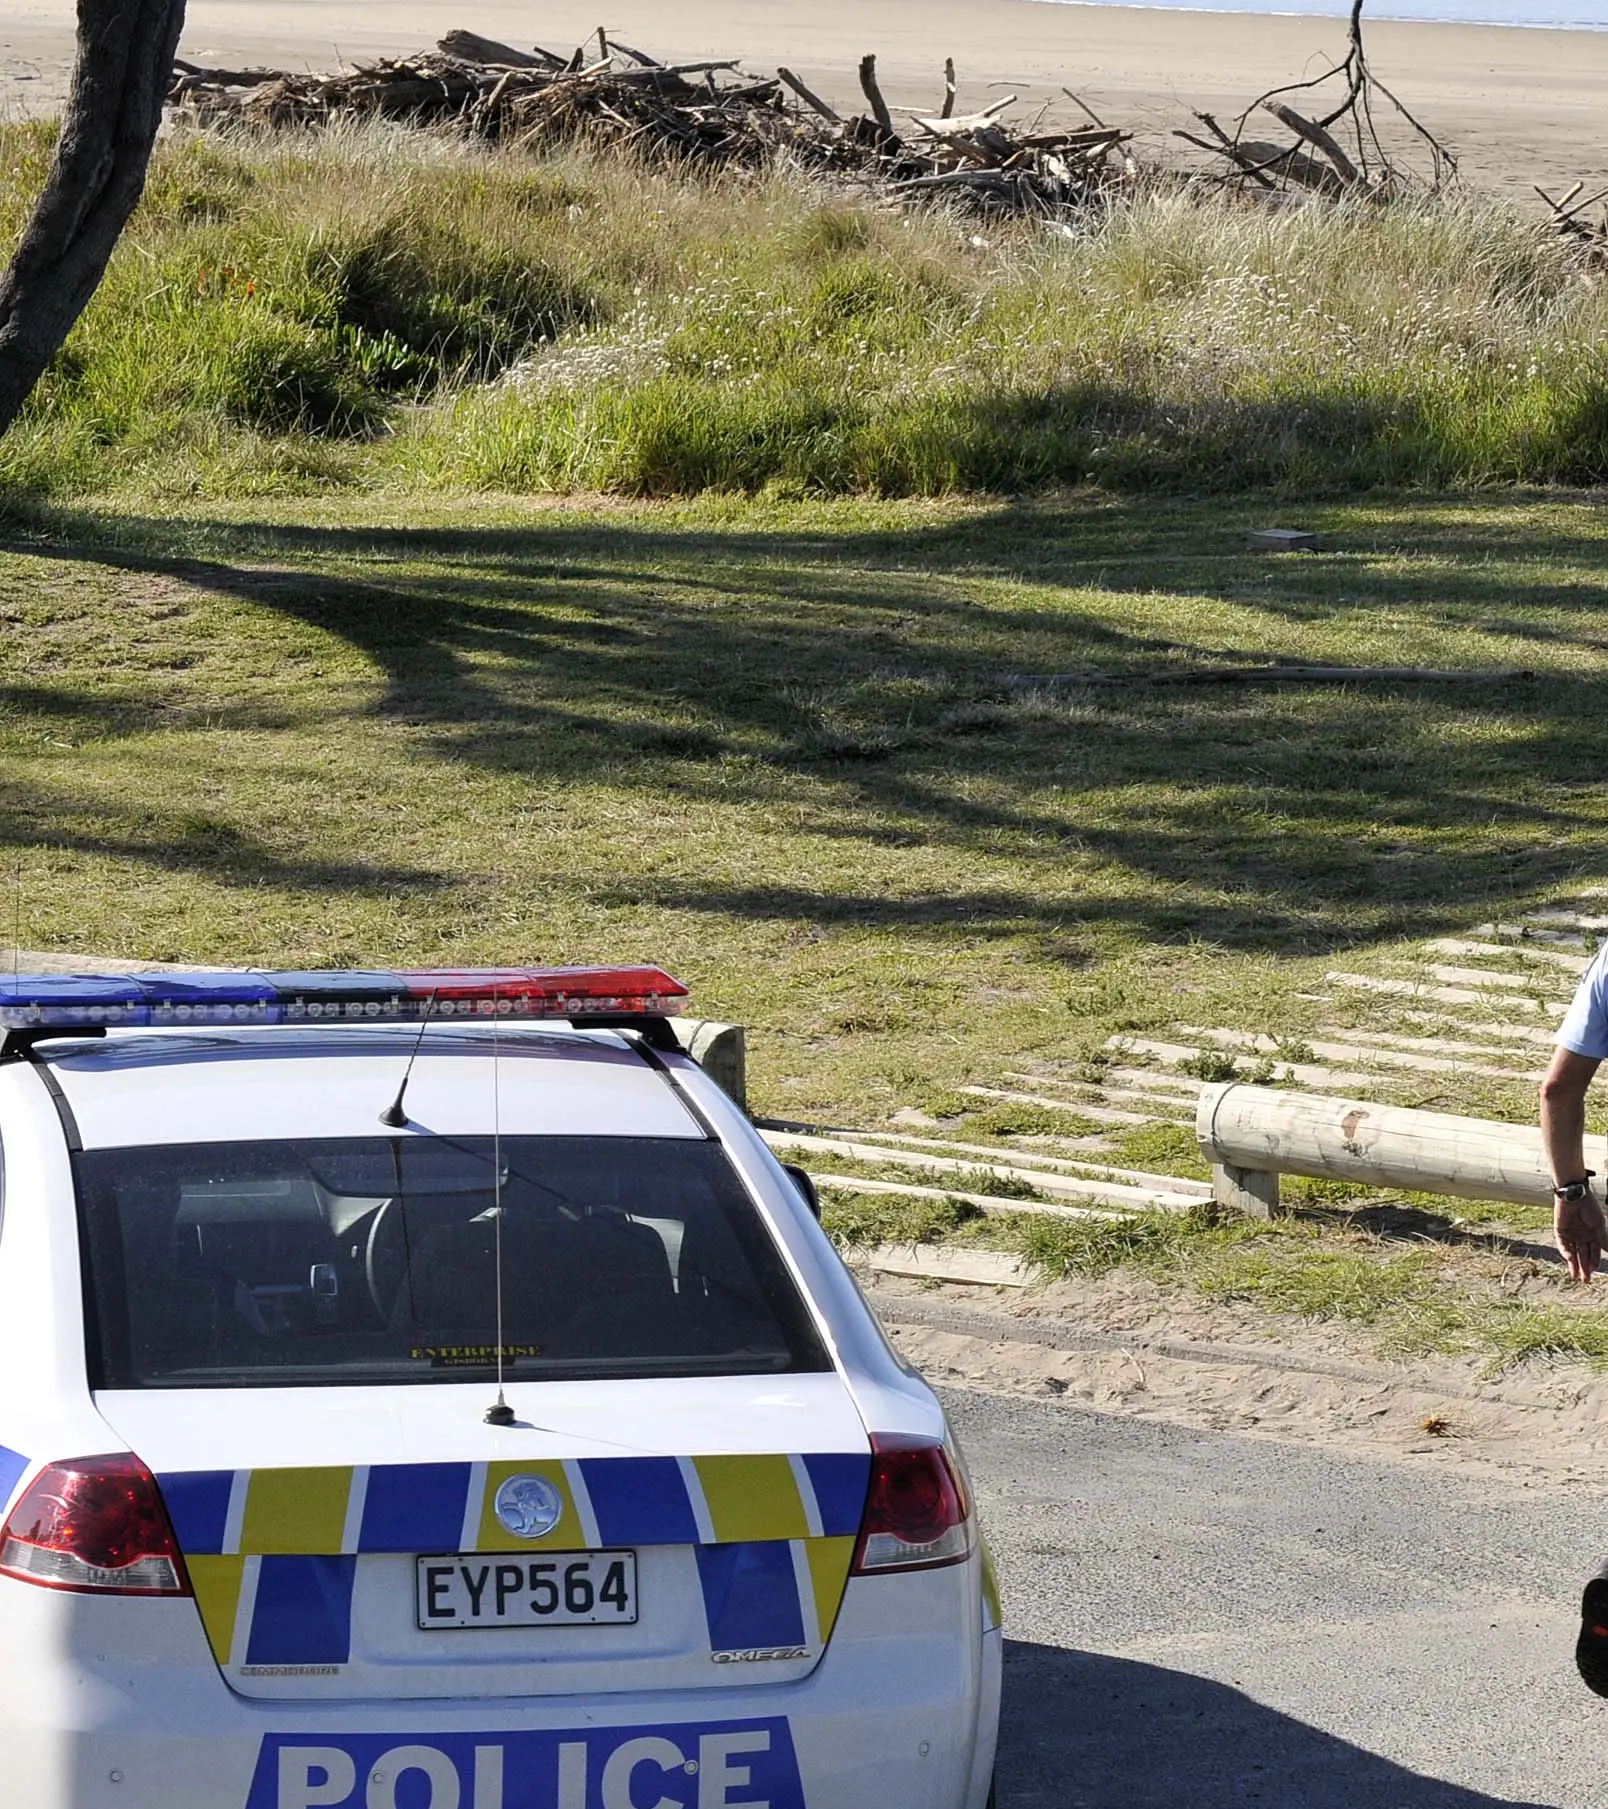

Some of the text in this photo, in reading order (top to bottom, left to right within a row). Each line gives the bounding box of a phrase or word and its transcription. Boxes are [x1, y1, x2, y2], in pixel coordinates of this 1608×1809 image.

[410, 1346, 541, 1358] ENTERPRISE
[426, 1560, 628, 1617] EYP564
[711, 1648, 811, 1663] OMEGA
[278, 1730, 771, 1809] POLICE
